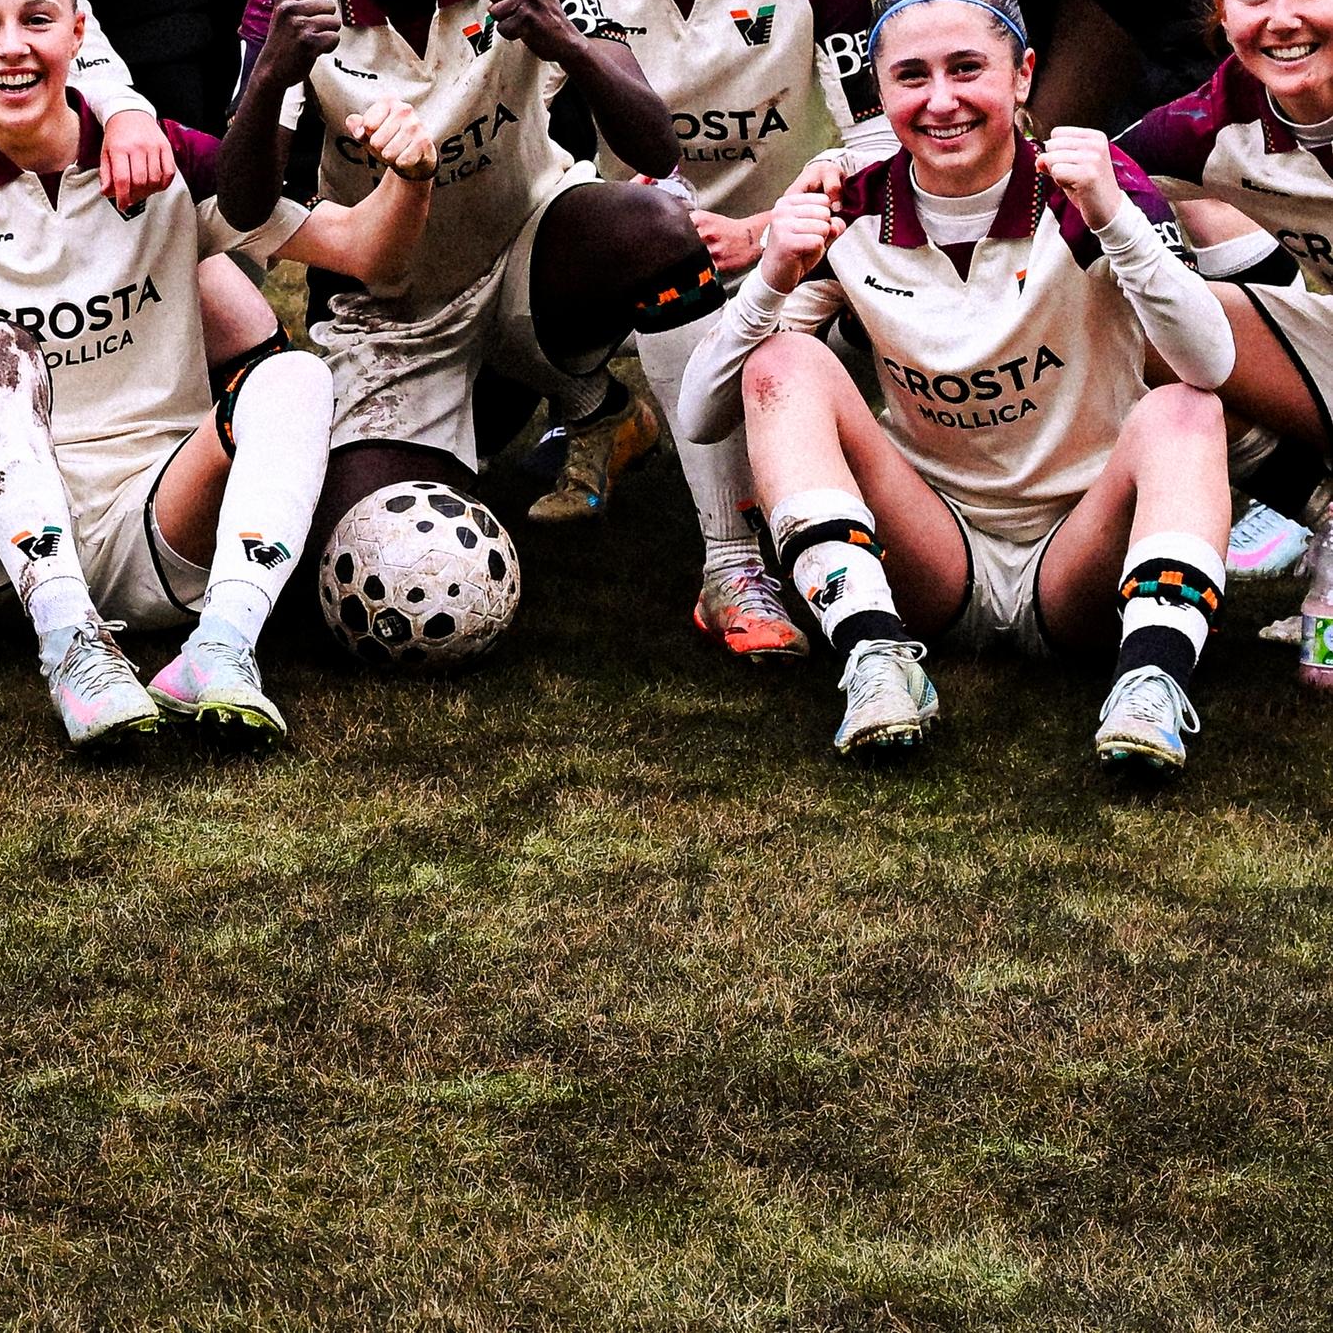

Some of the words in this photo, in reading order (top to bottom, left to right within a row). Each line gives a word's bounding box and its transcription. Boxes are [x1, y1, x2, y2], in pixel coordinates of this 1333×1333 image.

[671, 106, 790, 141] OSTA
[45, 329, 134, 369] OLLICA
[883, 344, 1065, 404] CROSTA
[918, 398, 1037, 429] MOLLICA
